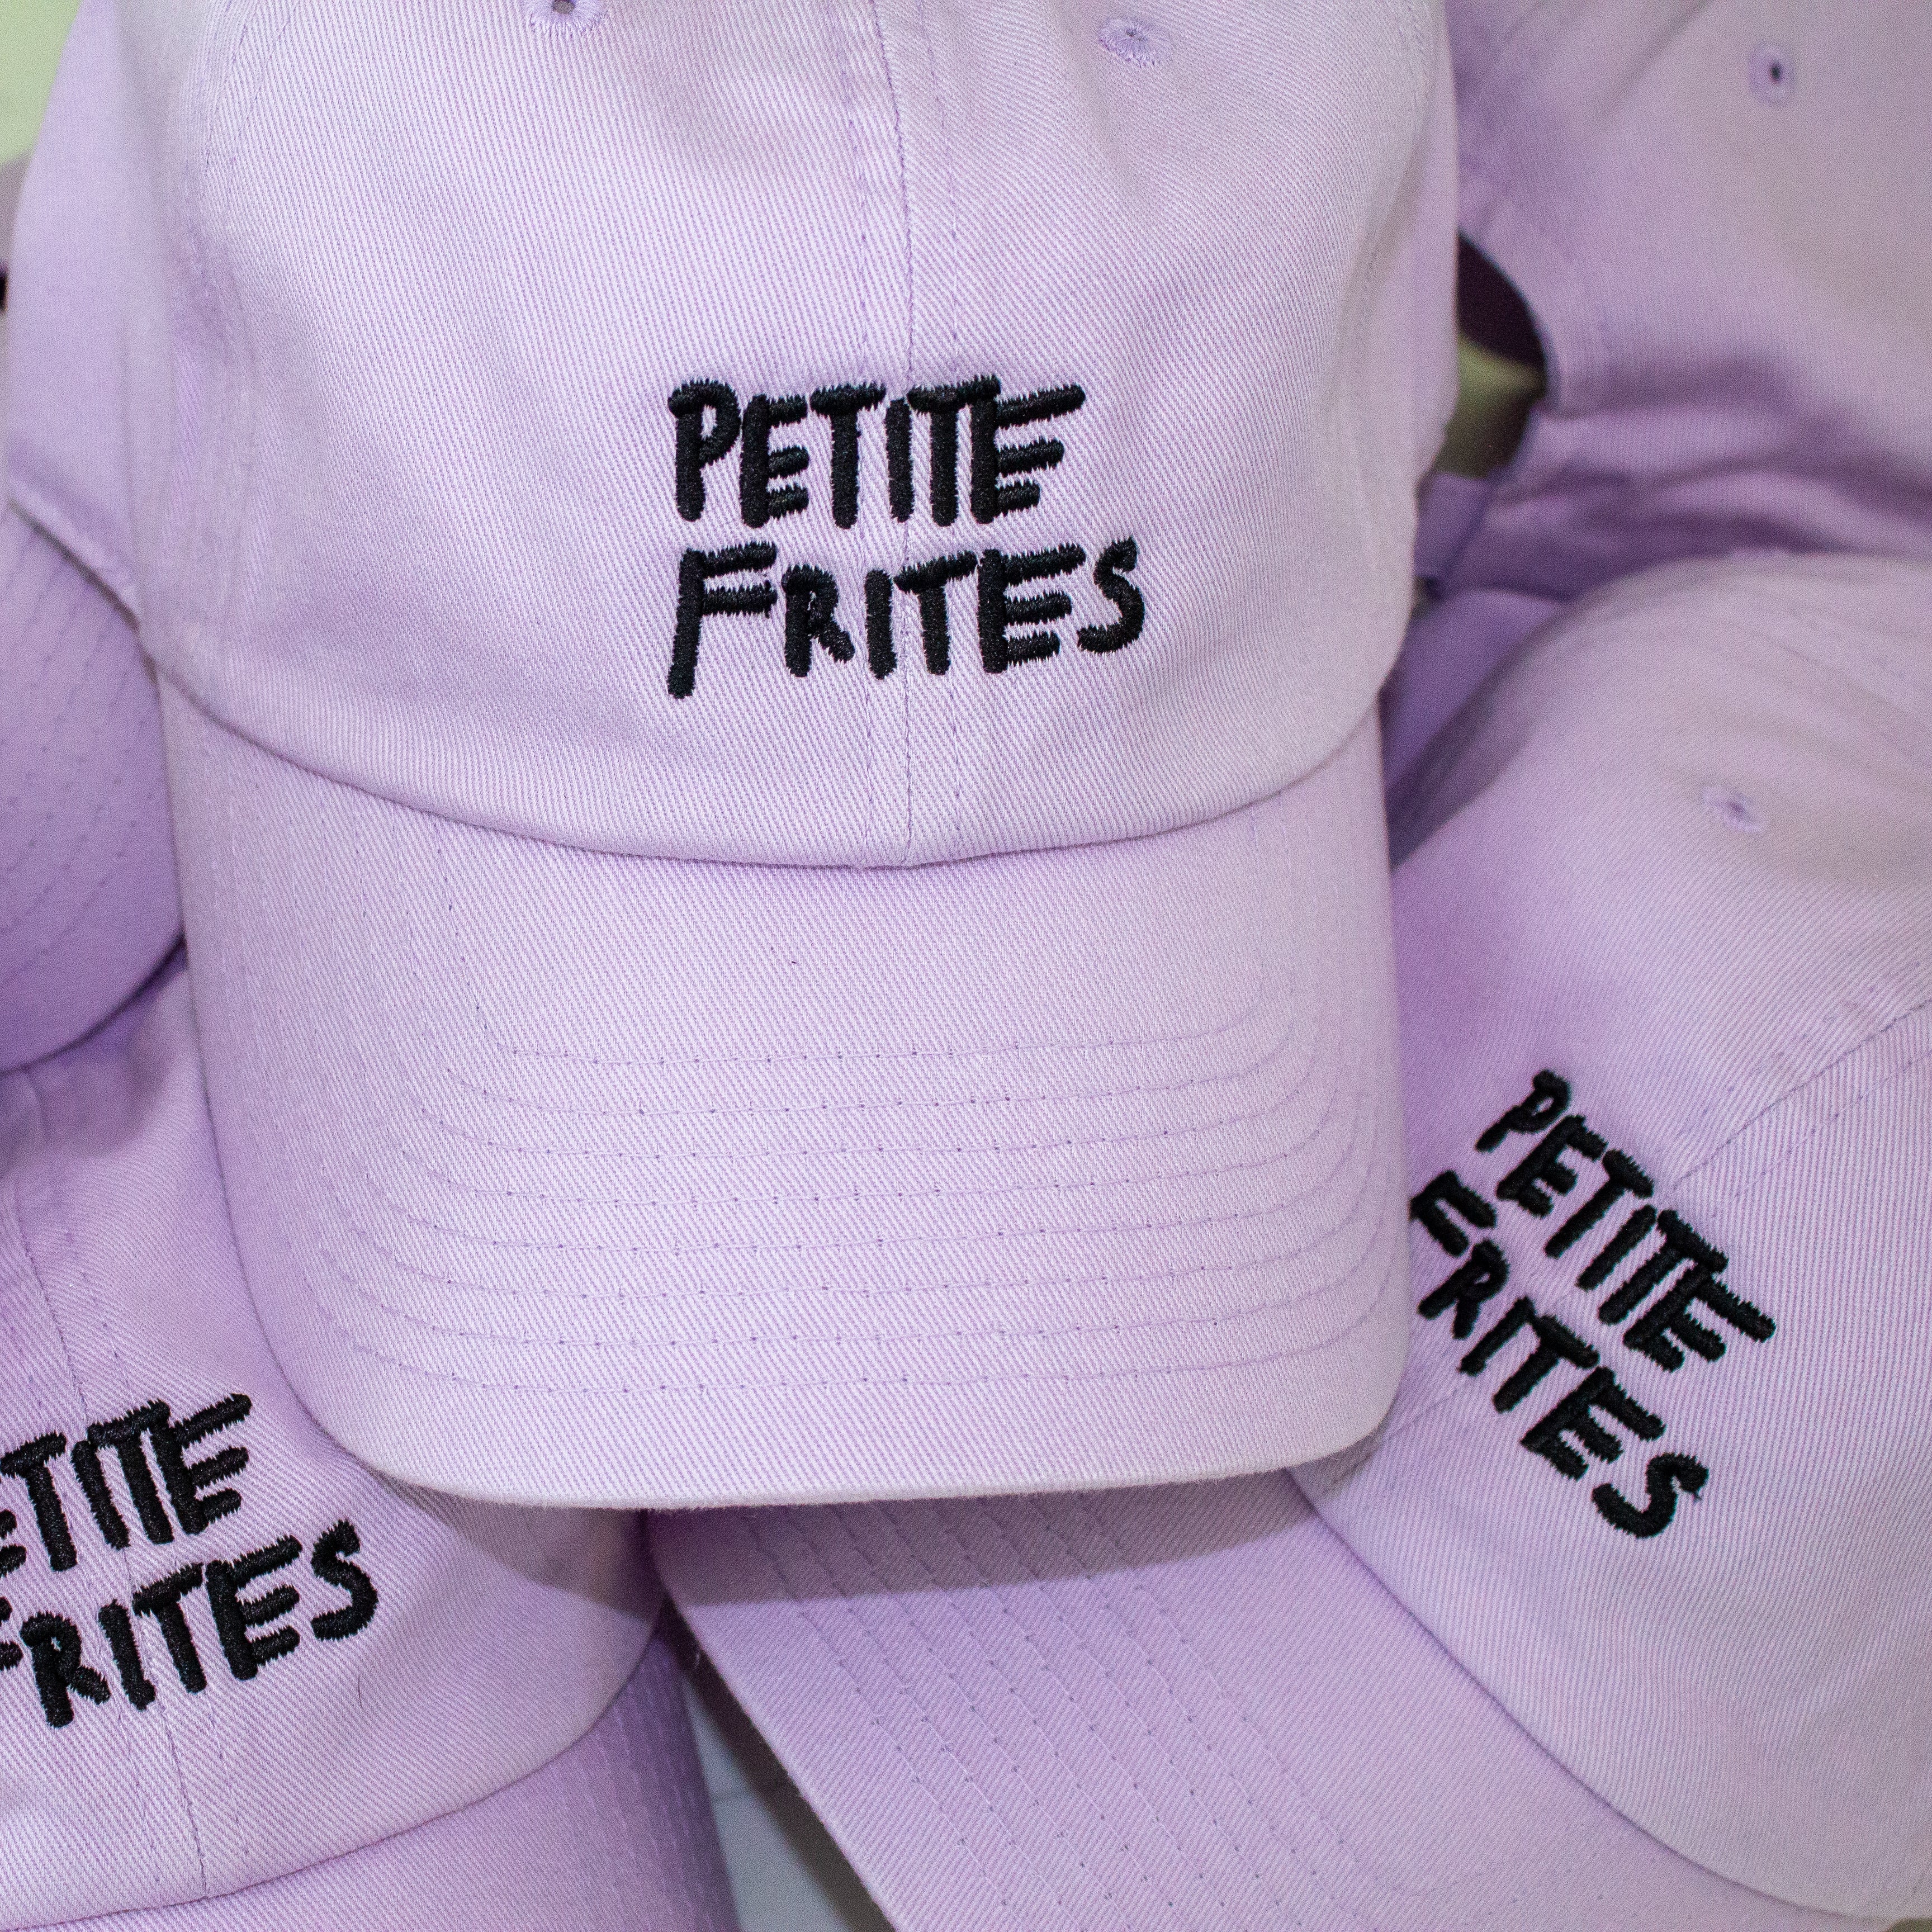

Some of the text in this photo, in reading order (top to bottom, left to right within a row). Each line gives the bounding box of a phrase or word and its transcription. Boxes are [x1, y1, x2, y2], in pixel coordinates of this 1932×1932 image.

[667, 373, 1086, 529] PETITE
[666, 536, 1147, 699] FRITES
[1474, 1068, 1777, 1373] PETITE
[0, 1519, 379, 1728] RITES
